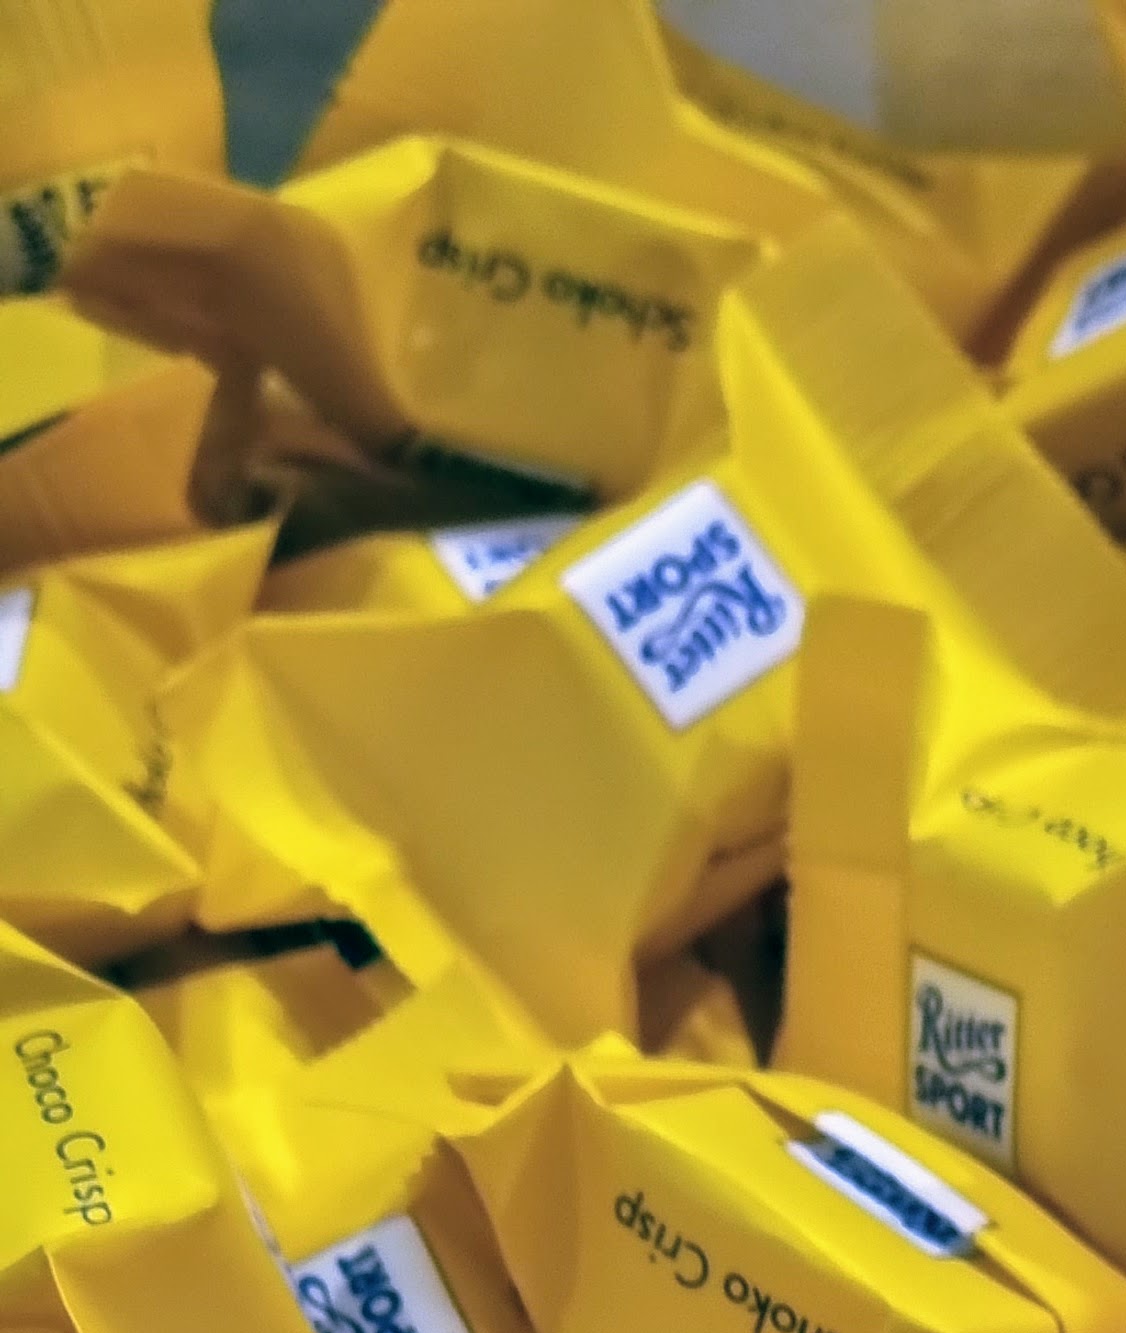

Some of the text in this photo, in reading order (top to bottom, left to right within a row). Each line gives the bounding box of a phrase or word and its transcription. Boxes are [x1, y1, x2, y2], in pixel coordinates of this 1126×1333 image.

[606, 518, 744, 634] SPORT
[917, 985, 1007, 1080] Ritter
[13, 1028, 113, 1228] Choco Crisp
[914, 1064, 1006, 1142] SPORT
[613, 1190, 712, 1290] Crisp
